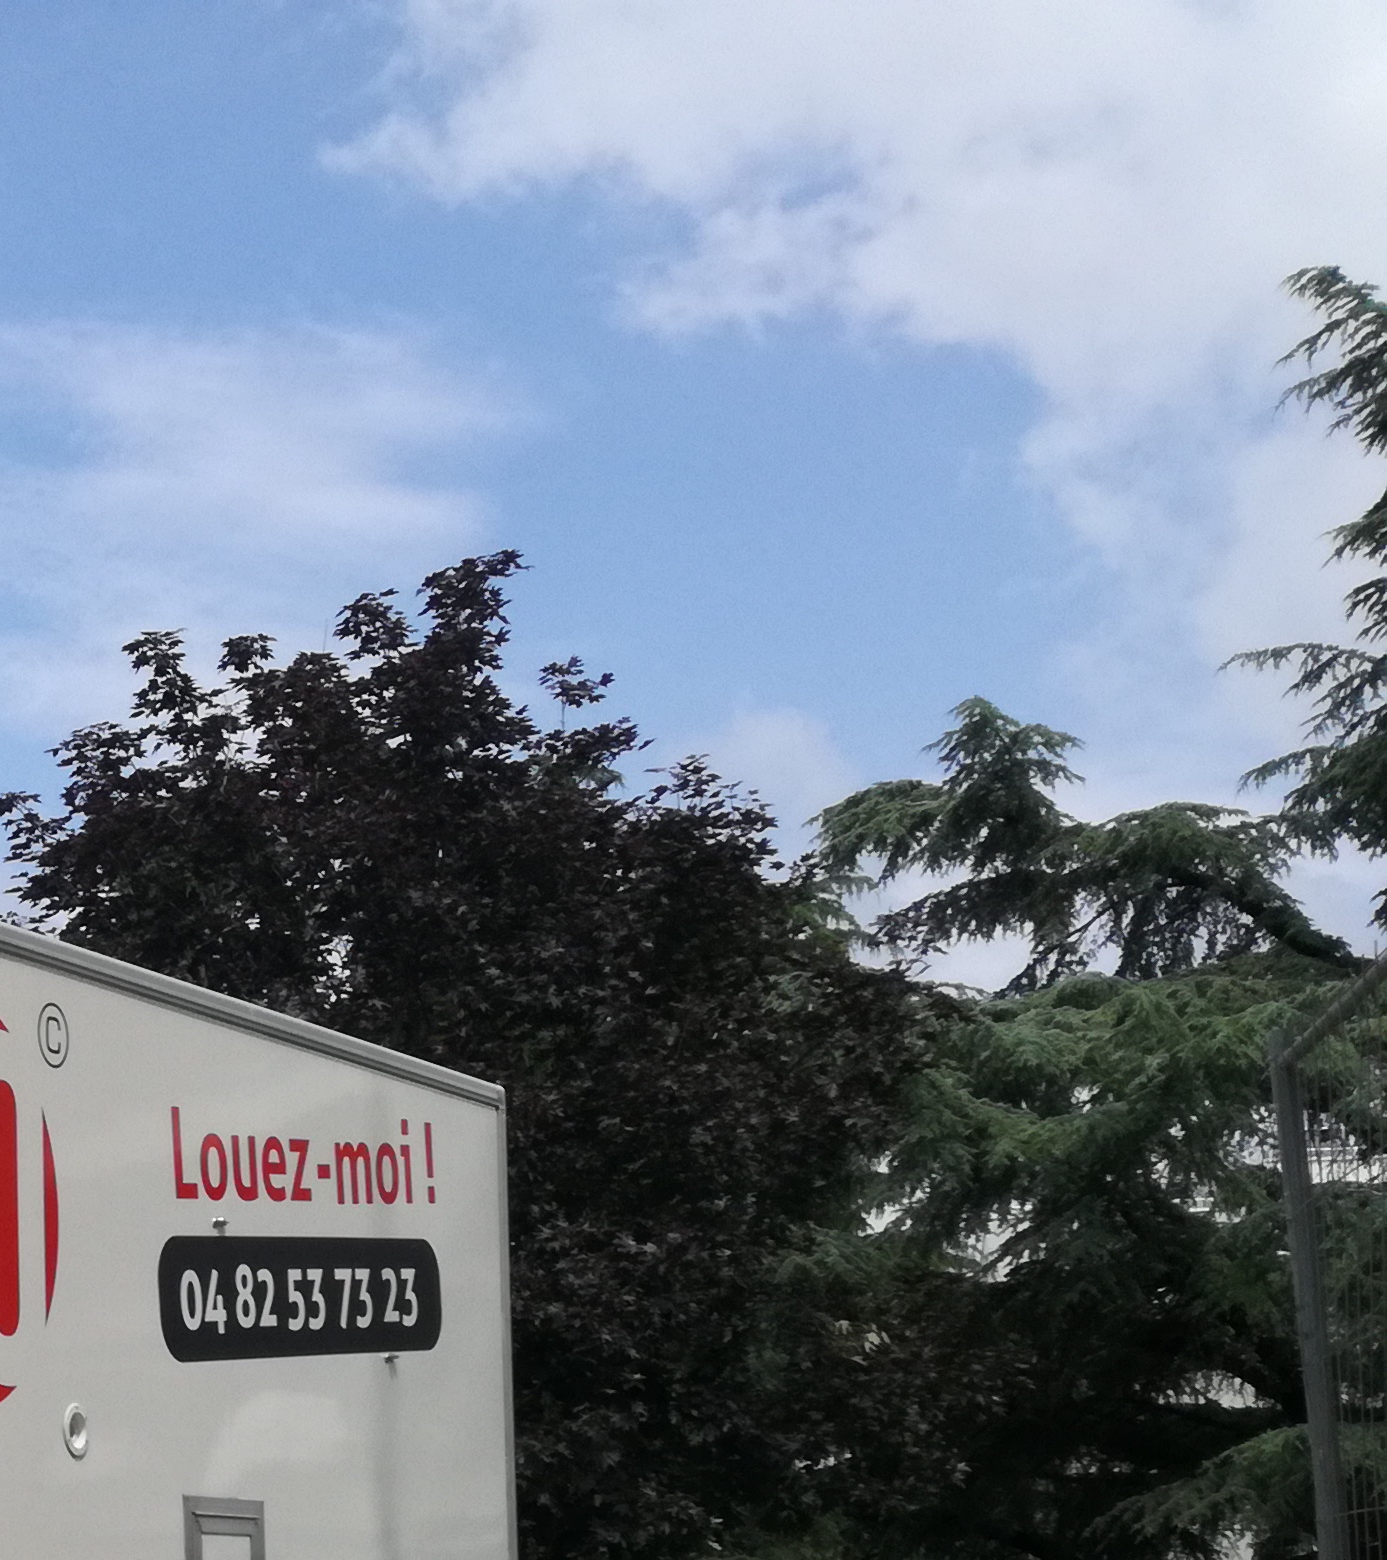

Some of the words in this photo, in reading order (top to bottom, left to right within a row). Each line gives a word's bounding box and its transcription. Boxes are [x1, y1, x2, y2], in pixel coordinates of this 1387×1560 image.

[180, 1268, 227, 1334] 04
[235, 1263, 277, 1329] 82
[287, 1268, 326, 1331] 53
[334, 1267, 373, 1330] 73
[381, 1267, 419, 1327] 23
